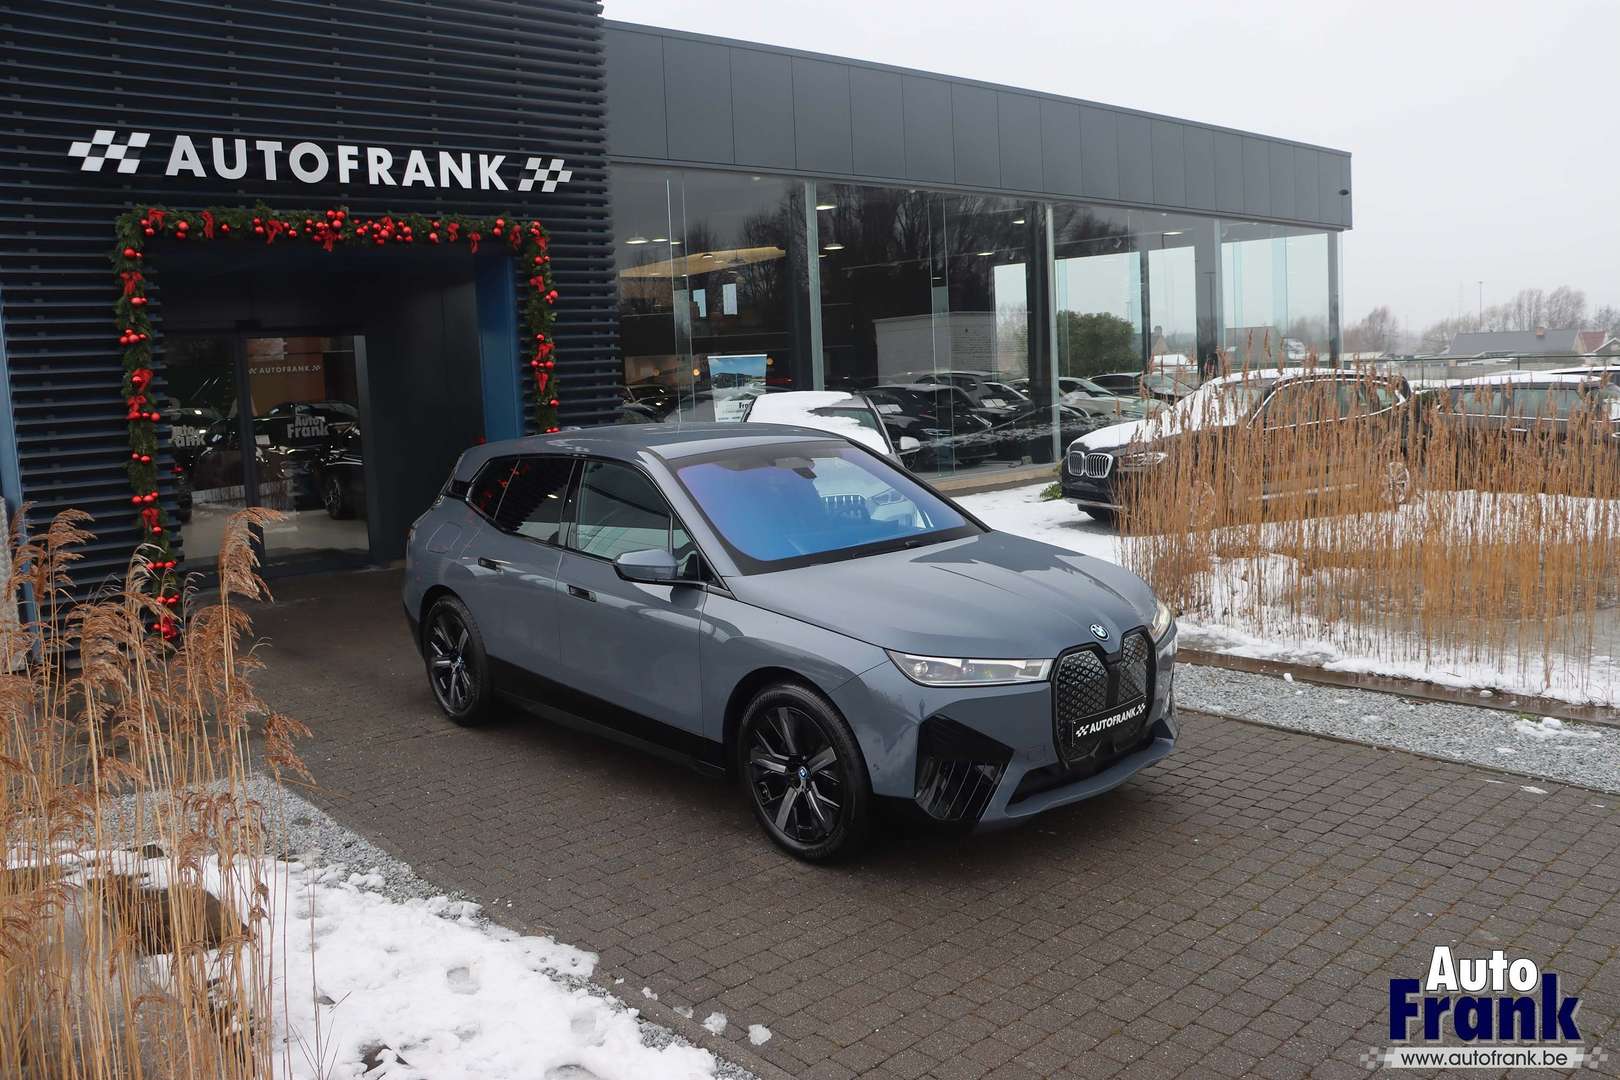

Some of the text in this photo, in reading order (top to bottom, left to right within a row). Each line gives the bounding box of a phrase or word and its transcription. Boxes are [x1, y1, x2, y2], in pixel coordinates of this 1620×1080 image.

[165, 134, 510, 192] AUTOFRANK
[259, 365, 310, 374] AUTOFRANK
[295, 415, 319, 427] Auto
[287, 422, 329, 438] Frank
[1089, 707, 1137, 733] AUTOFRANK
